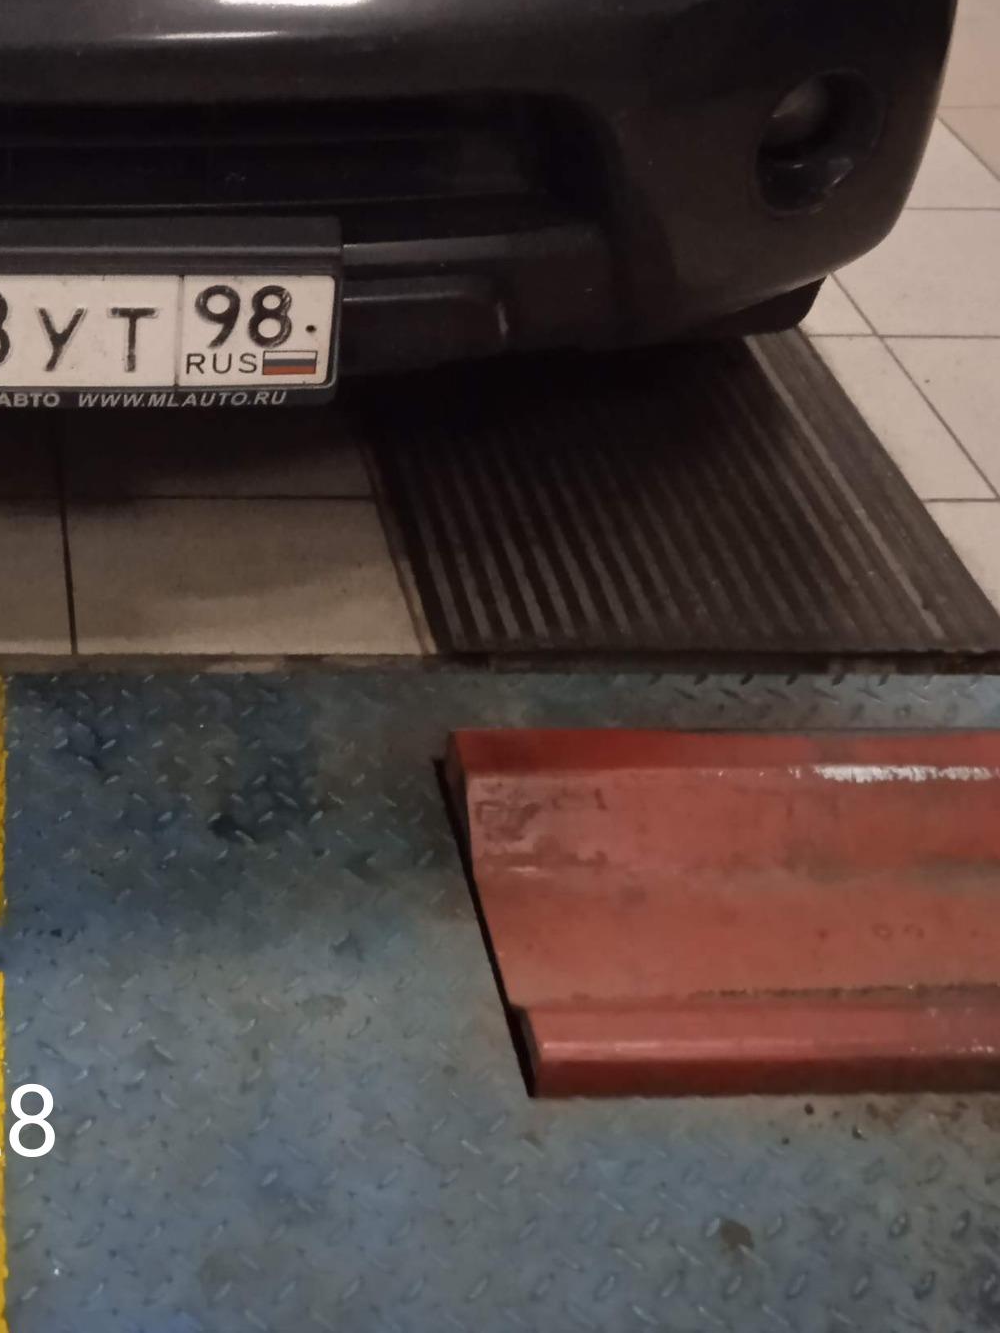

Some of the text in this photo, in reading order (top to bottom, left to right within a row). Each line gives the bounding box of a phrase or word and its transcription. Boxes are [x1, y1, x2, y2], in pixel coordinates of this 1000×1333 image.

[194, 285, 292, 348] 98
[185, 352, 258, 375] RUS
[77, 391, 288, 408] WWW.MLAUTO.RU
